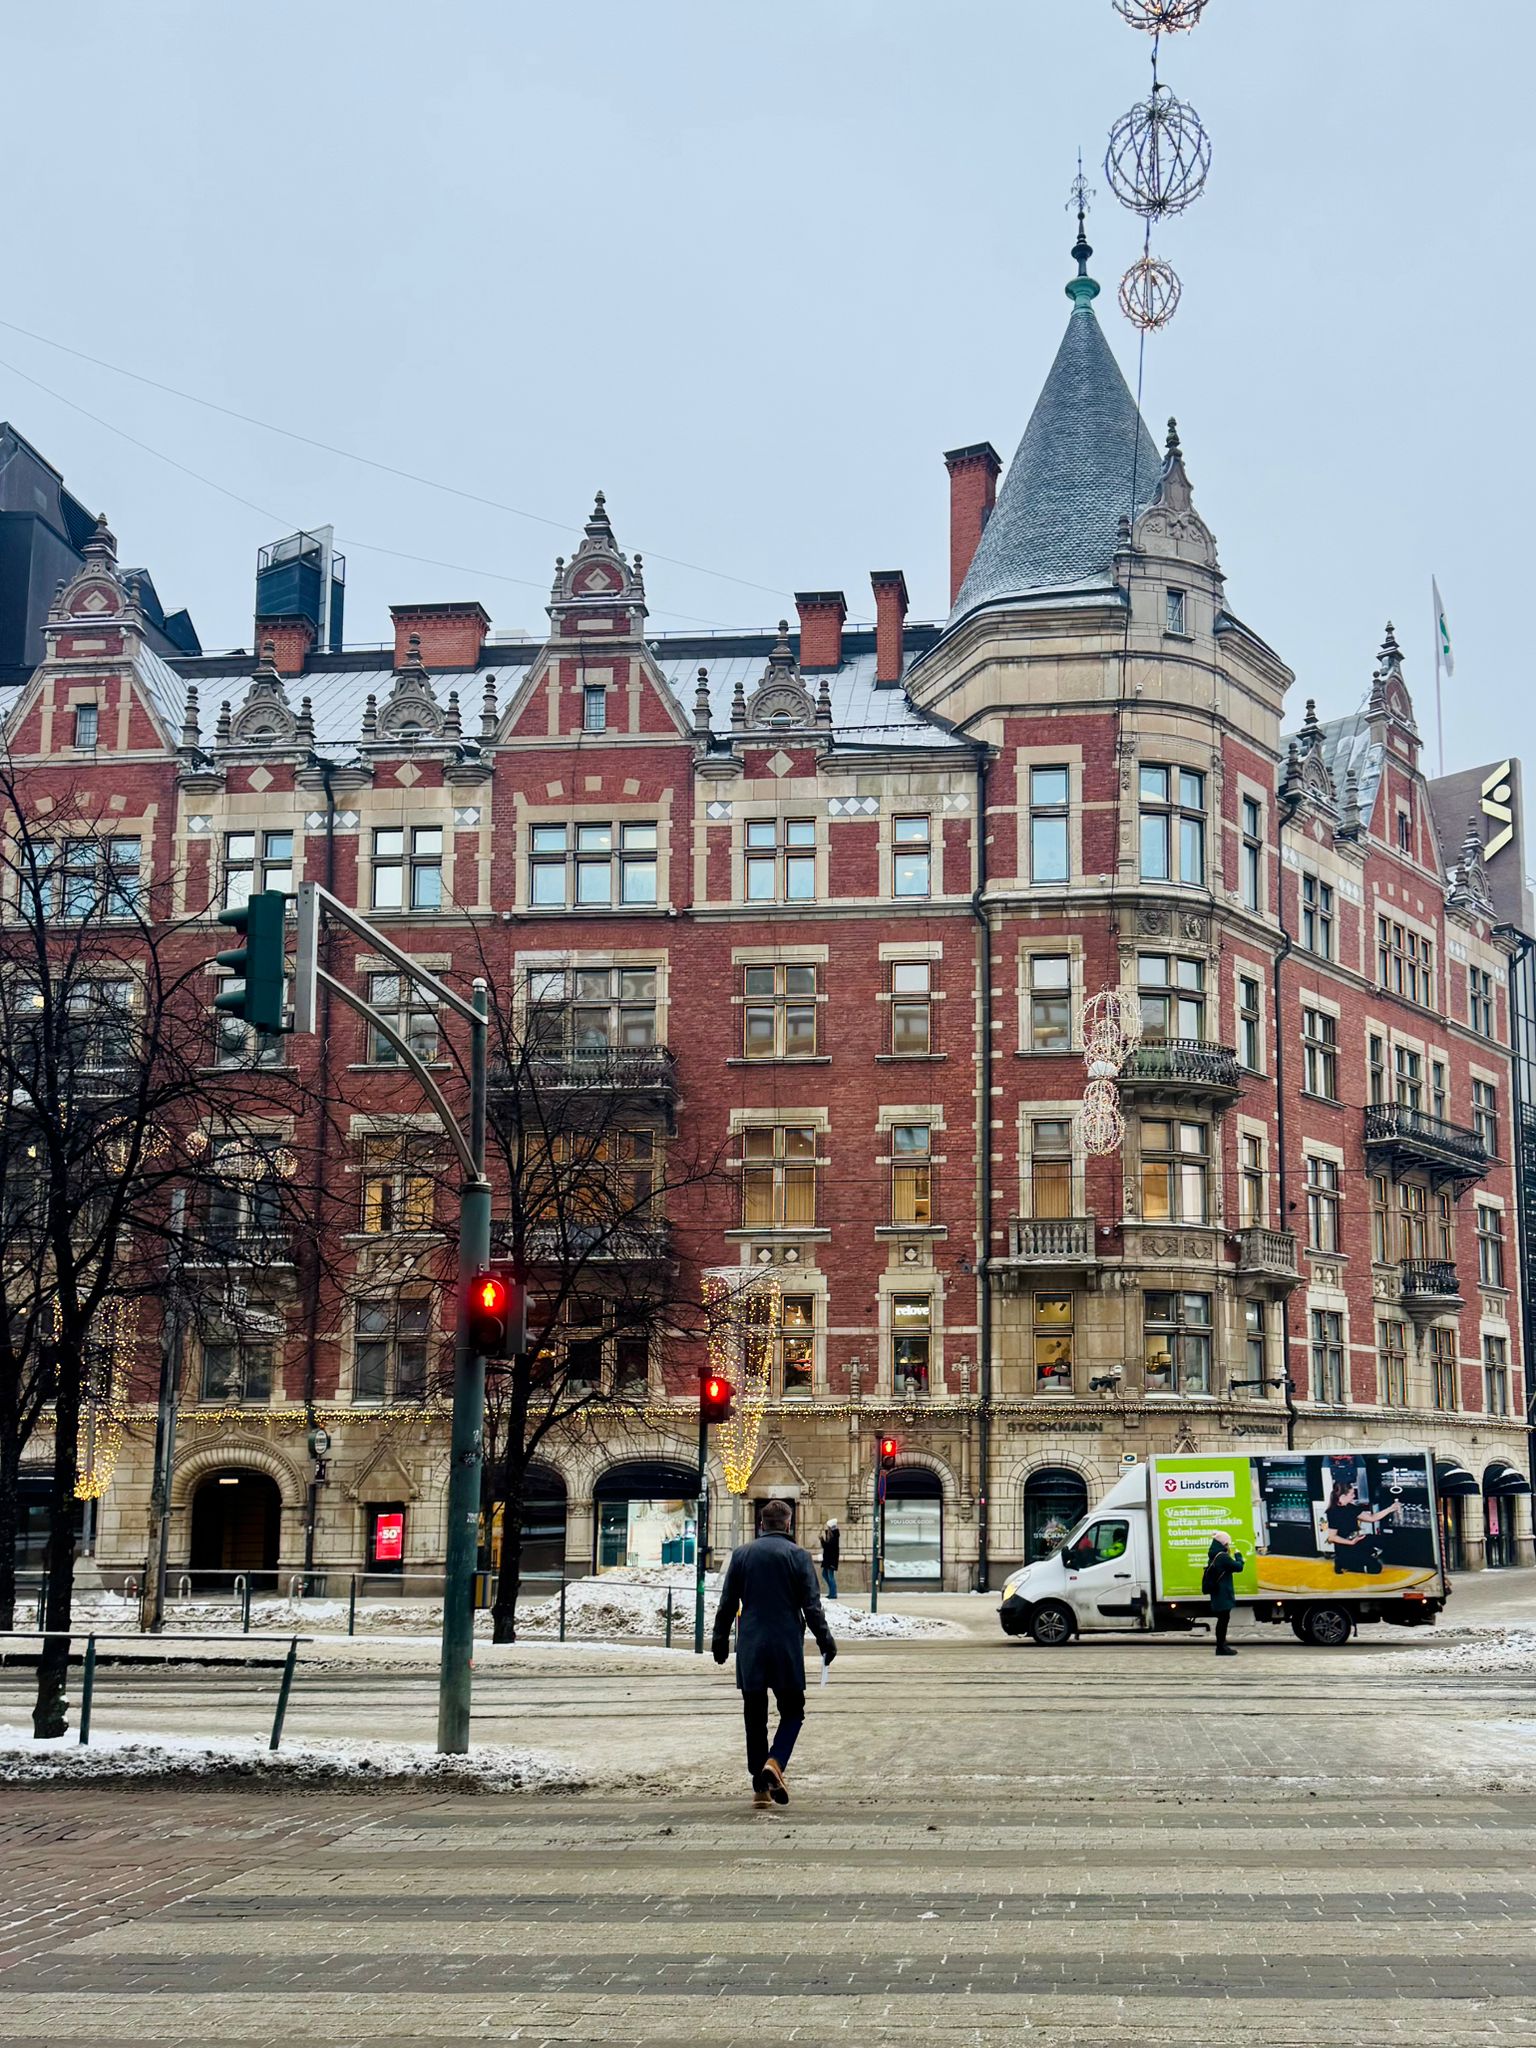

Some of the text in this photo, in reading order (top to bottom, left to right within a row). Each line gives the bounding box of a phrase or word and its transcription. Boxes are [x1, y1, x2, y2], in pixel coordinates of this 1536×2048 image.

[895, 1305, 930, 1316] relove
[1007, 1421, 1103, 1433] STOCKMANN
[1180, 1479, 1229, 1490] Lindström
[1167, 1507, 1227, 1518] Vastuullinen
[1168, 1518, 1198, 1527] auttaa
